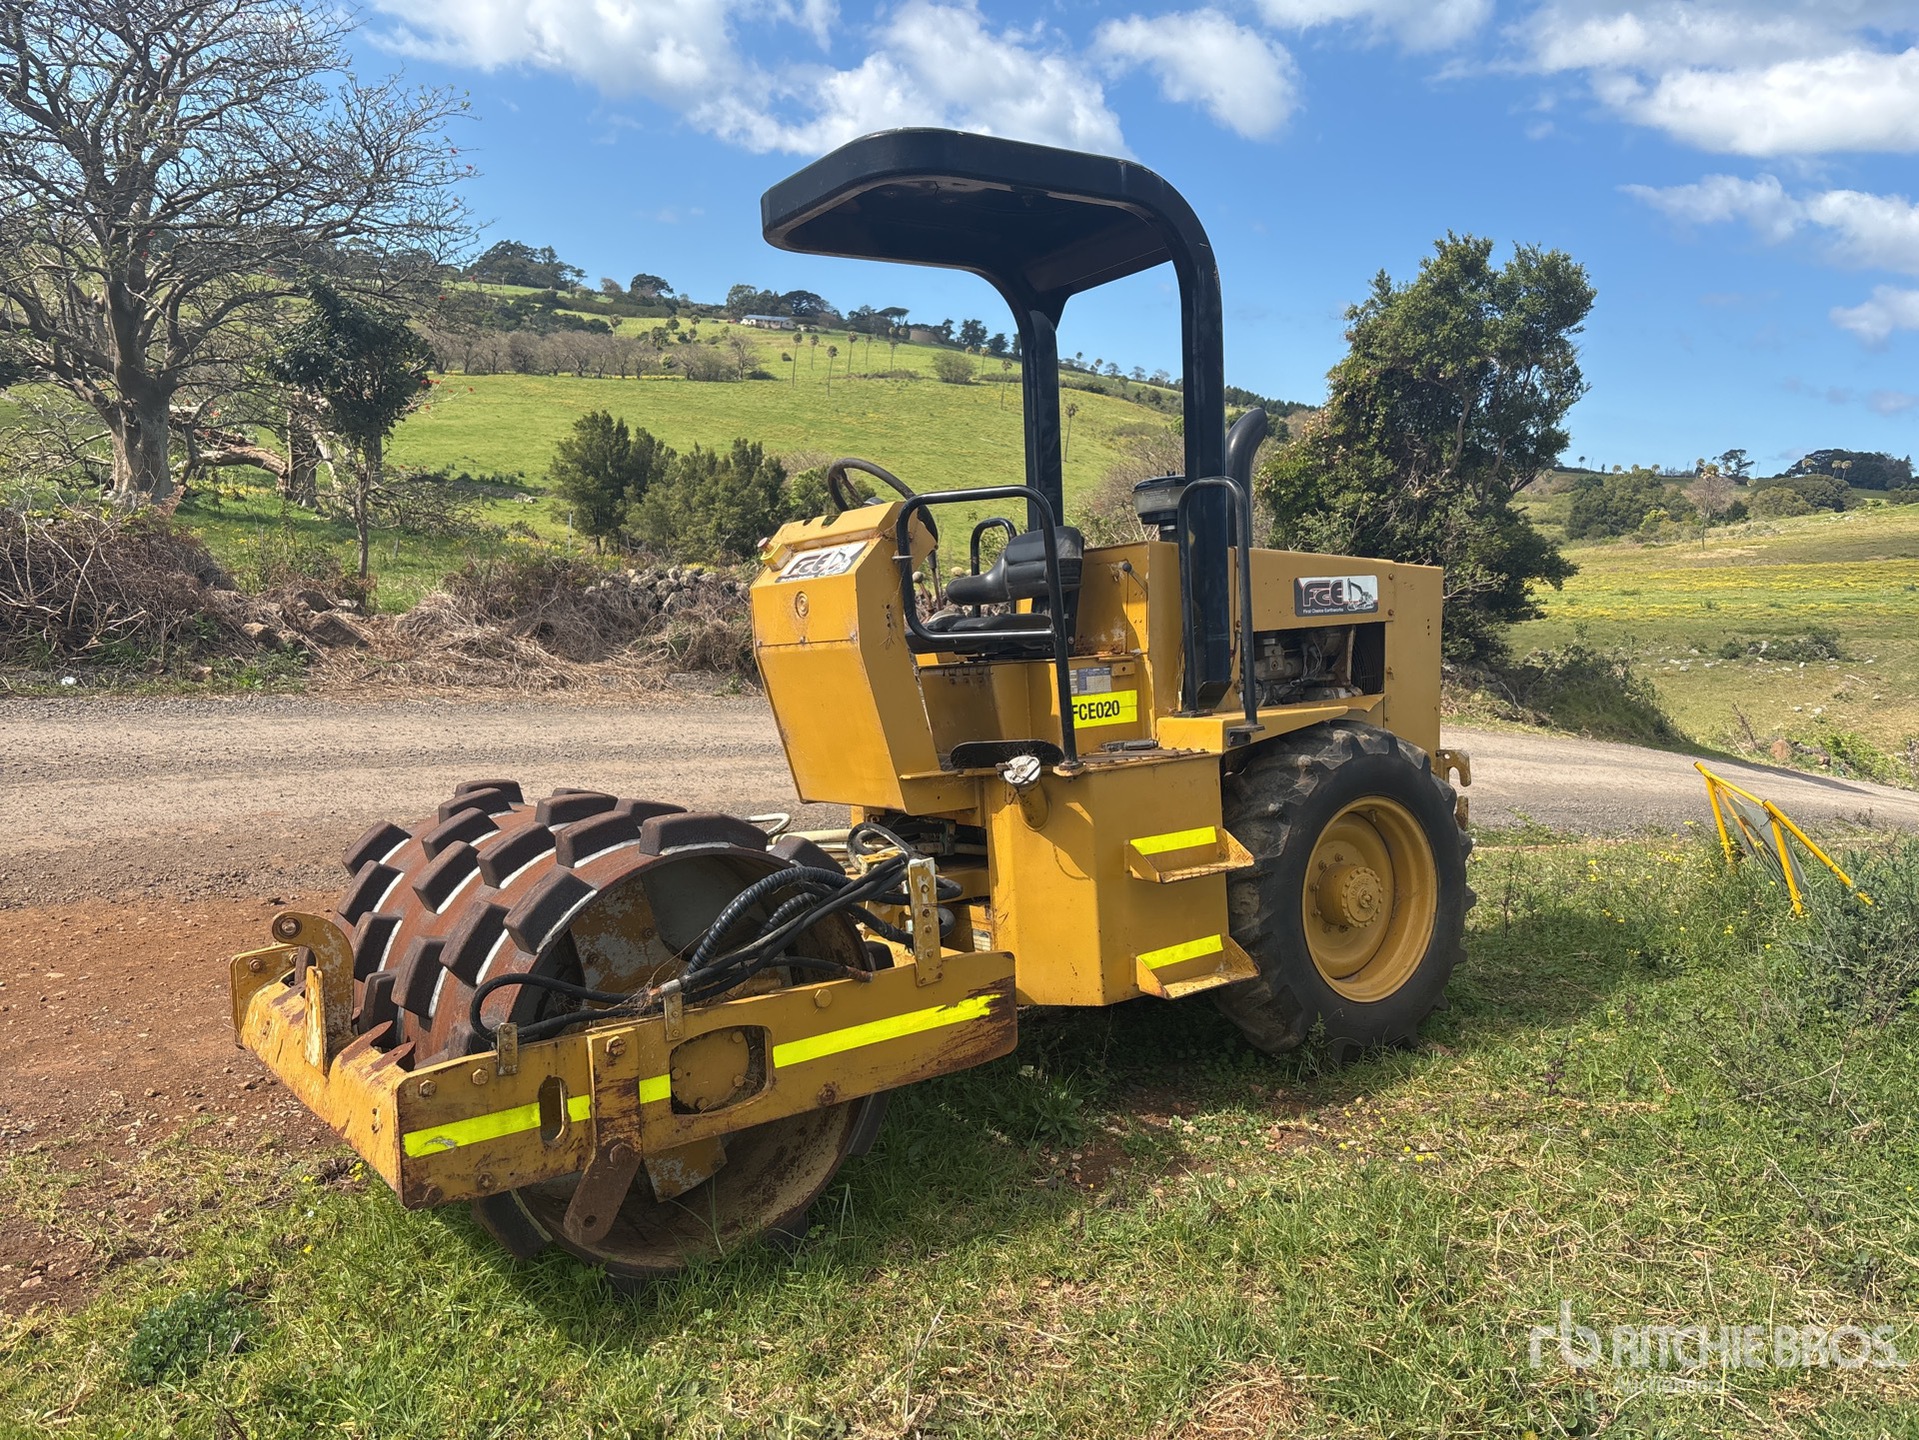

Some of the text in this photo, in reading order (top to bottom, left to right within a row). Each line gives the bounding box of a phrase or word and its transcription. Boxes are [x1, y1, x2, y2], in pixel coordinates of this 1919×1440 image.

[786, 553, 832, 576] FCE
[1302, 580, 1344, 607] FCE
[1072, 700, 1120, 721] FCE020
